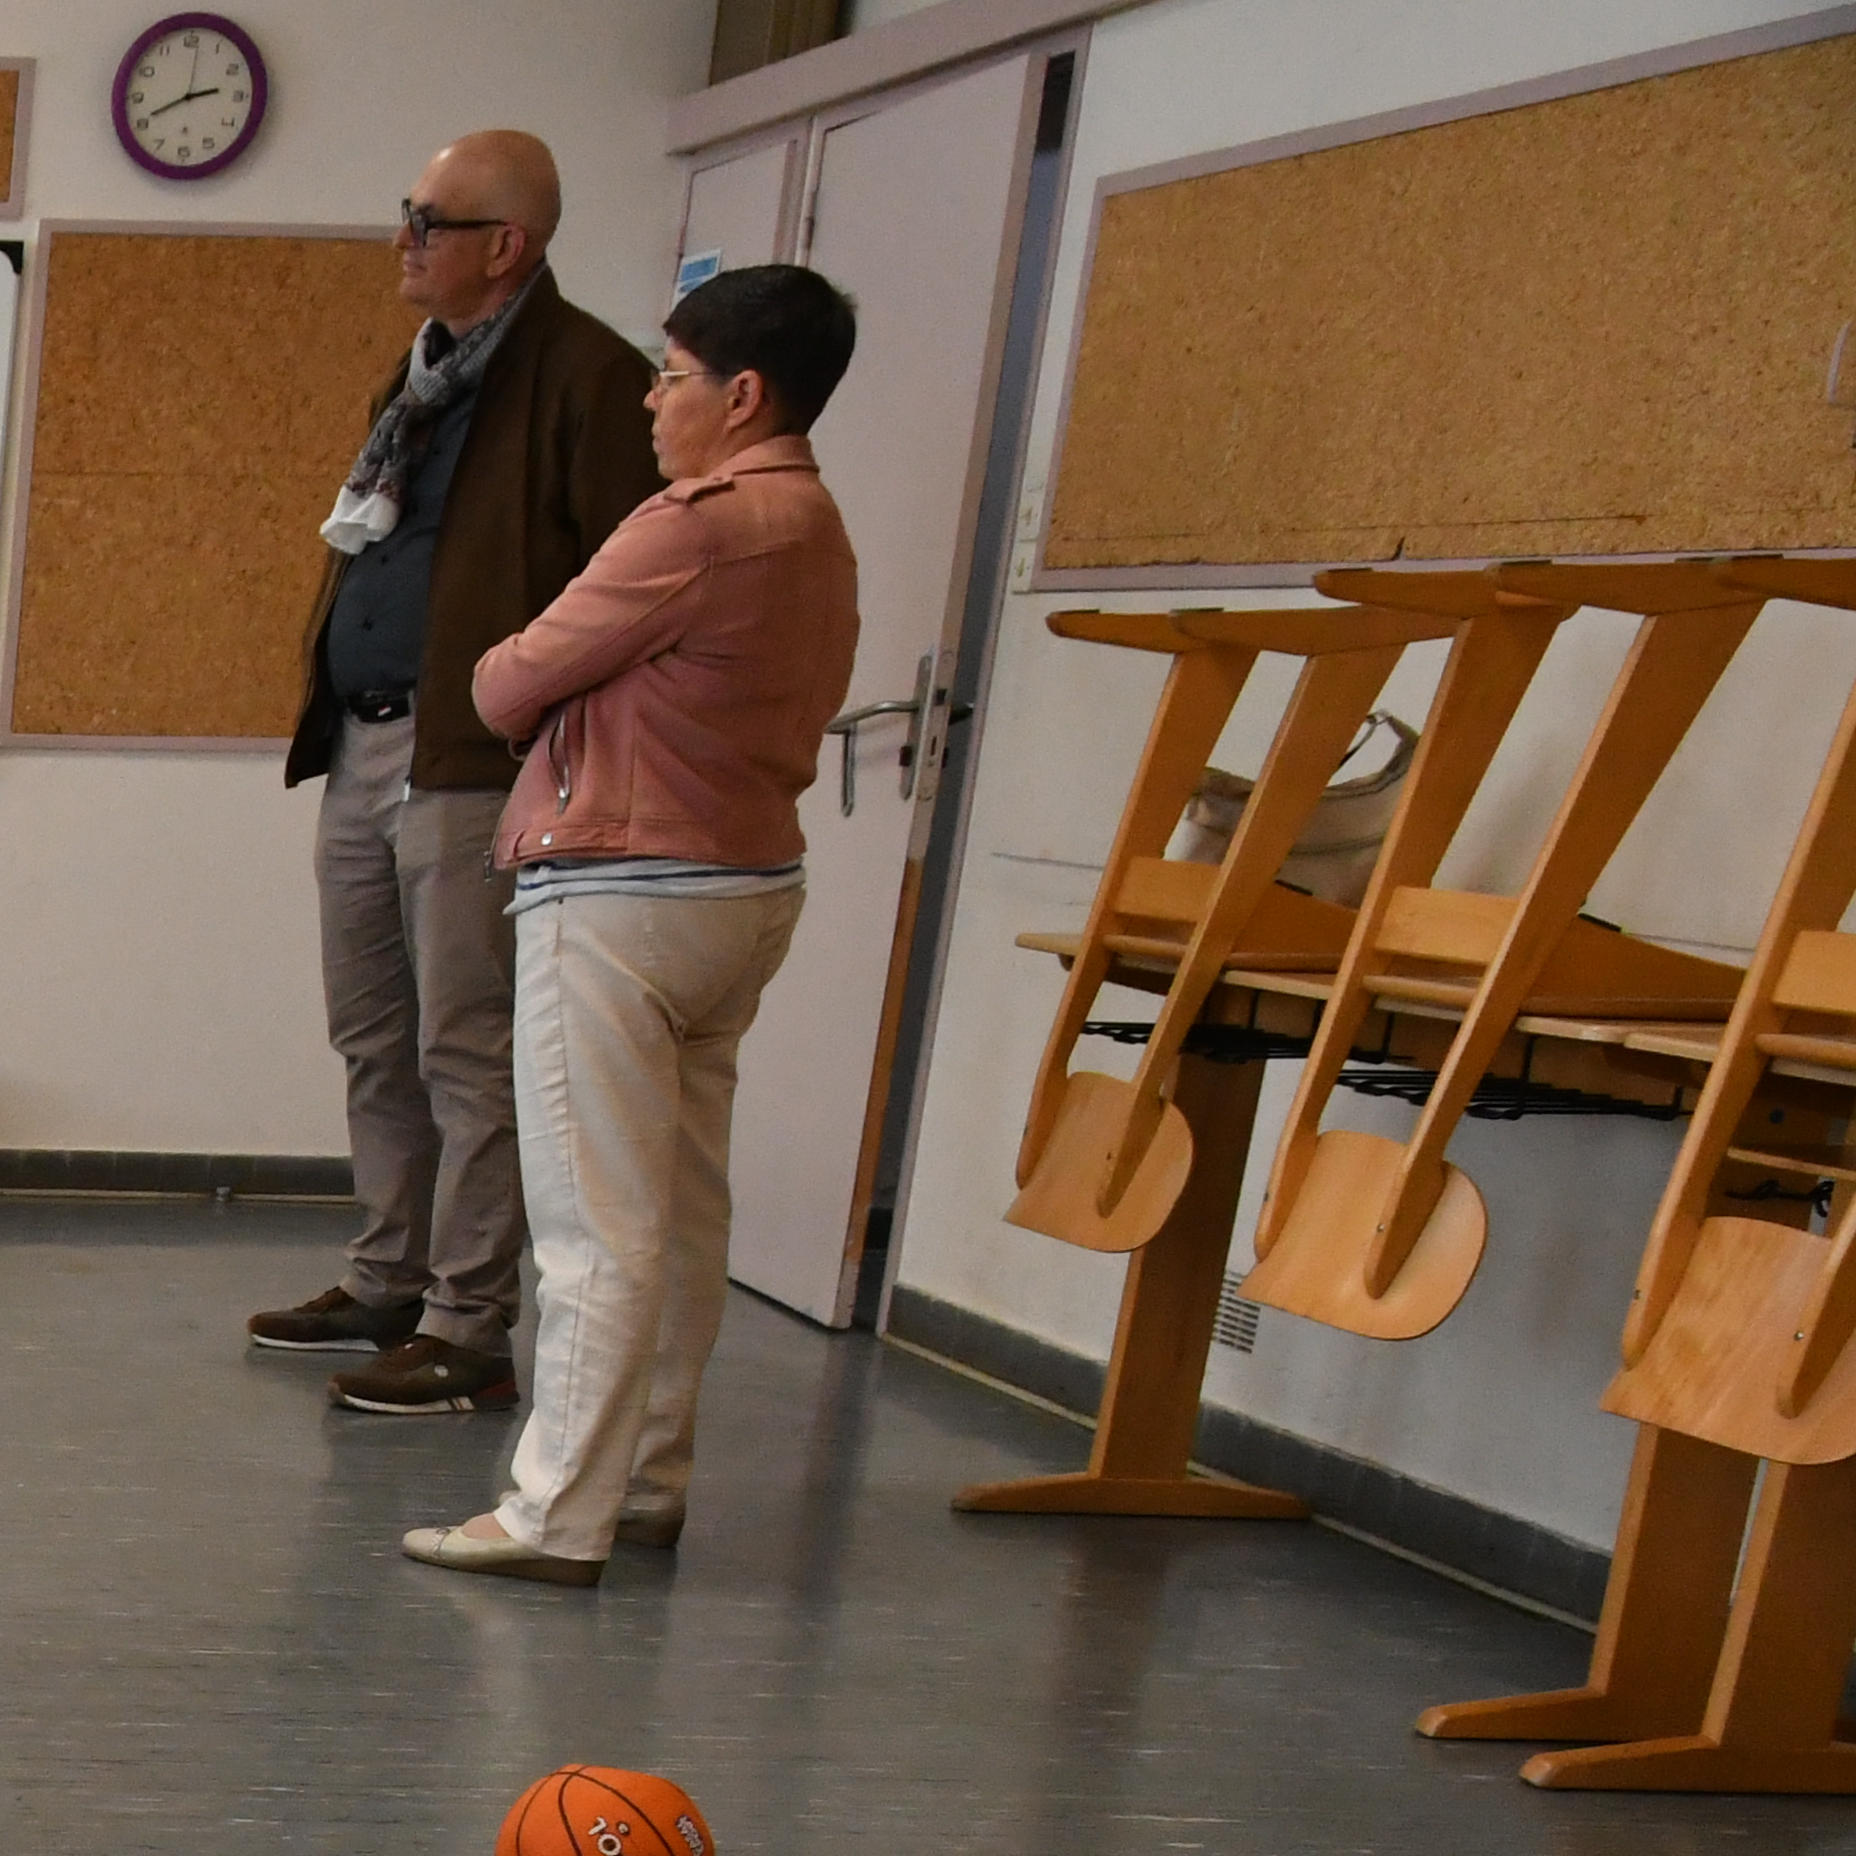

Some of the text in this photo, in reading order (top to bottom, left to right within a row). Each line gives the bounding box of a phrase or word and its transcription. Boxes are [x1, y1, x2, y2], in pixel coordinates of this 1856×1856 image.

[184, 34, 199, 48] 12
[139, 66, 155, 78] 10
[226, 63, 240, 76] 2
[131, 92, 144, 104] 9
[233, 90, 244, 103] 3
[221, 117, 235, 127] 4
[153, 139, 165, 153] 7
[202, 138, 215, 150] 5
[177, 146, 190, 158] 6
